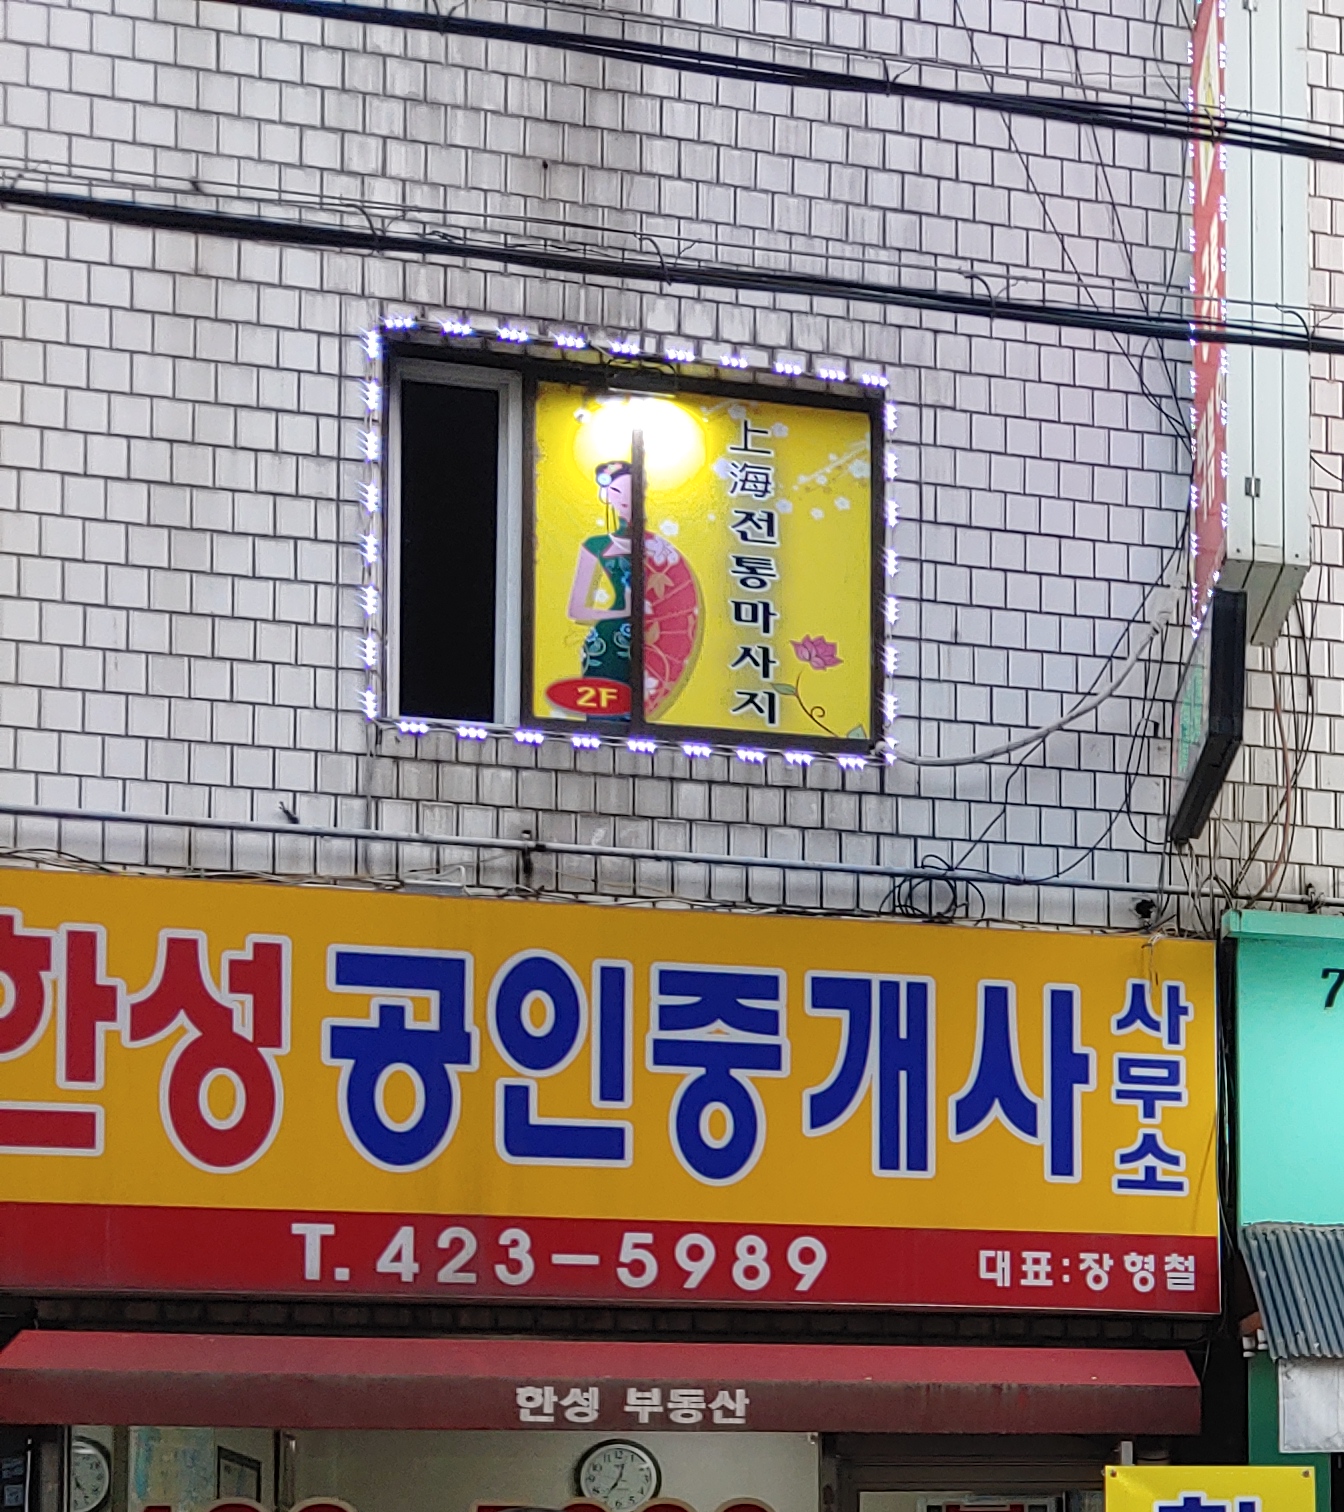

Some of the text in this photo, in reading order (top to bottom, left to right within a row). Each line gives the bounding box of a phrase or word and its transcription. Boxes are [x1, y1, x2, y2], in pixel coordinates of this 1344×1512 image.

[576, 686, 618, 708] 2F
[322, 944, 1097, 1186] 공인중개사
[1111, 978, 1193, 1197] 사무소
[515, 1386, 750, 1424] 한성 부동산
